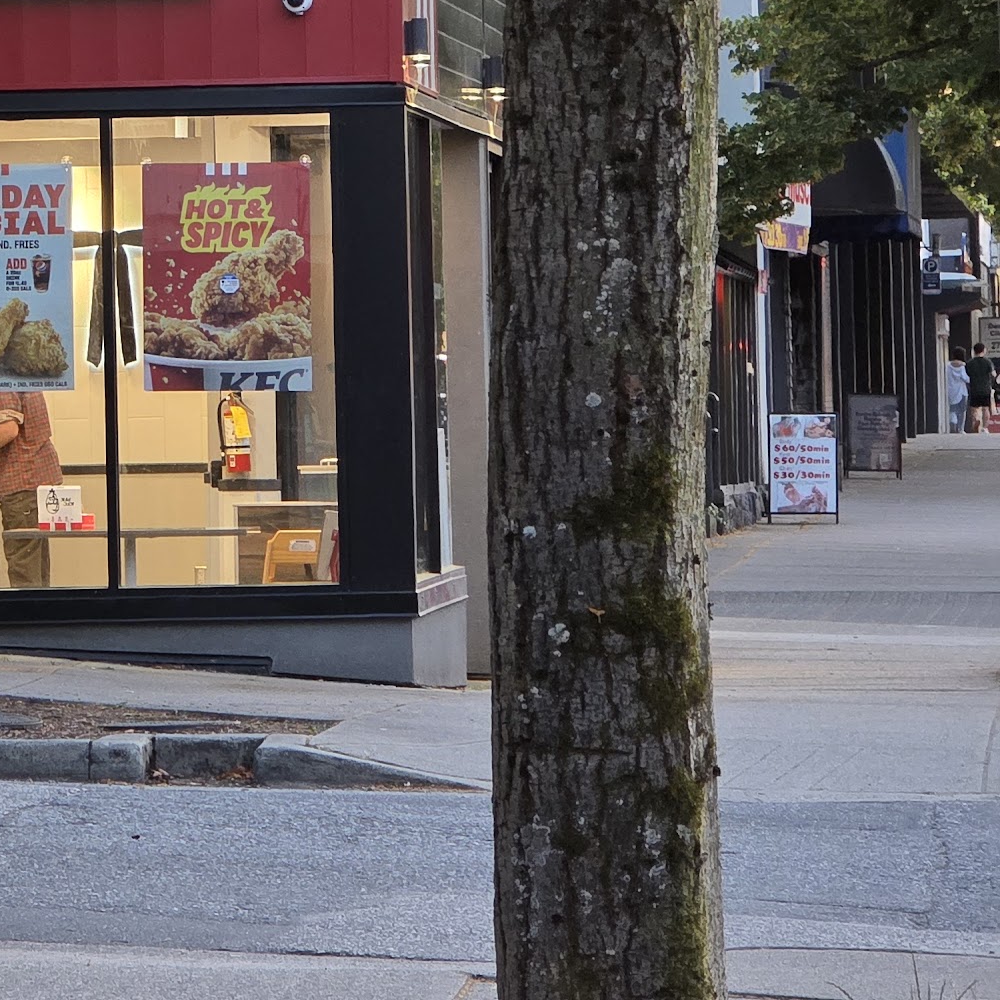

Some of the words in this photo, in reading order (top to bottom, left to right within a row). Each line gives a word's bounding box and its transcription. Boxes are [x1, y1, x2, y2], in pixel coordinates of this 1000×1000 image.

[185, 221, 269, 248] SPICY
[14, 240, 39, 249] FRIES
[6, 258, 27, 270] ADD
[219, 368, 305, 391] KFC
